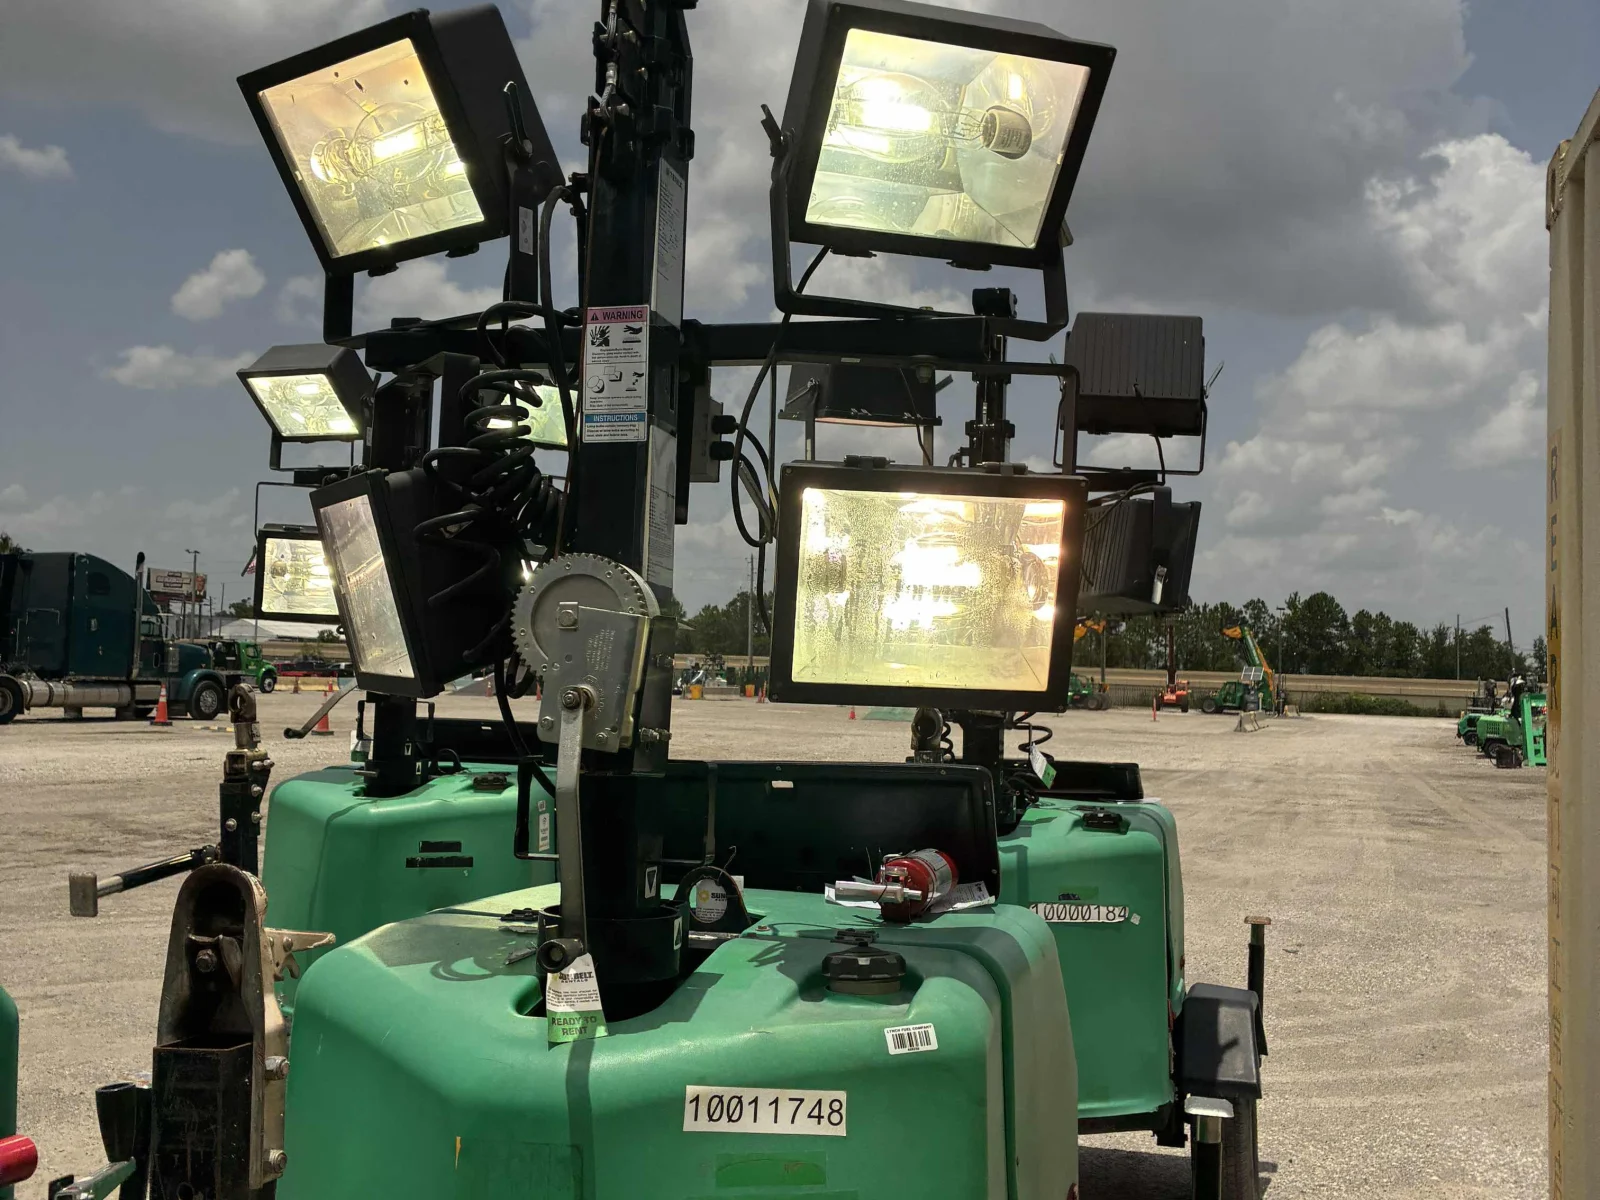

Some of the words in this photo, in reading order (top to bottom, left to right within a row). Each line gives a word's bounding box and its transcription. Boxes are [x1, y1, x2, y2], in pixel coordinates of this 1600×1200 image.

[602, 310, 643, 321] WARNING
[593, 414, 638, 422] INSTRUCTIONS
[1550, 445, 1558, 711] REAR
[551, 1016, 581, 1026] READY
[584, 1015, 597, 1024] TO
[562, 1026, 588, 1036] RENT
[689, 1094, 844, 1126] 10011748
